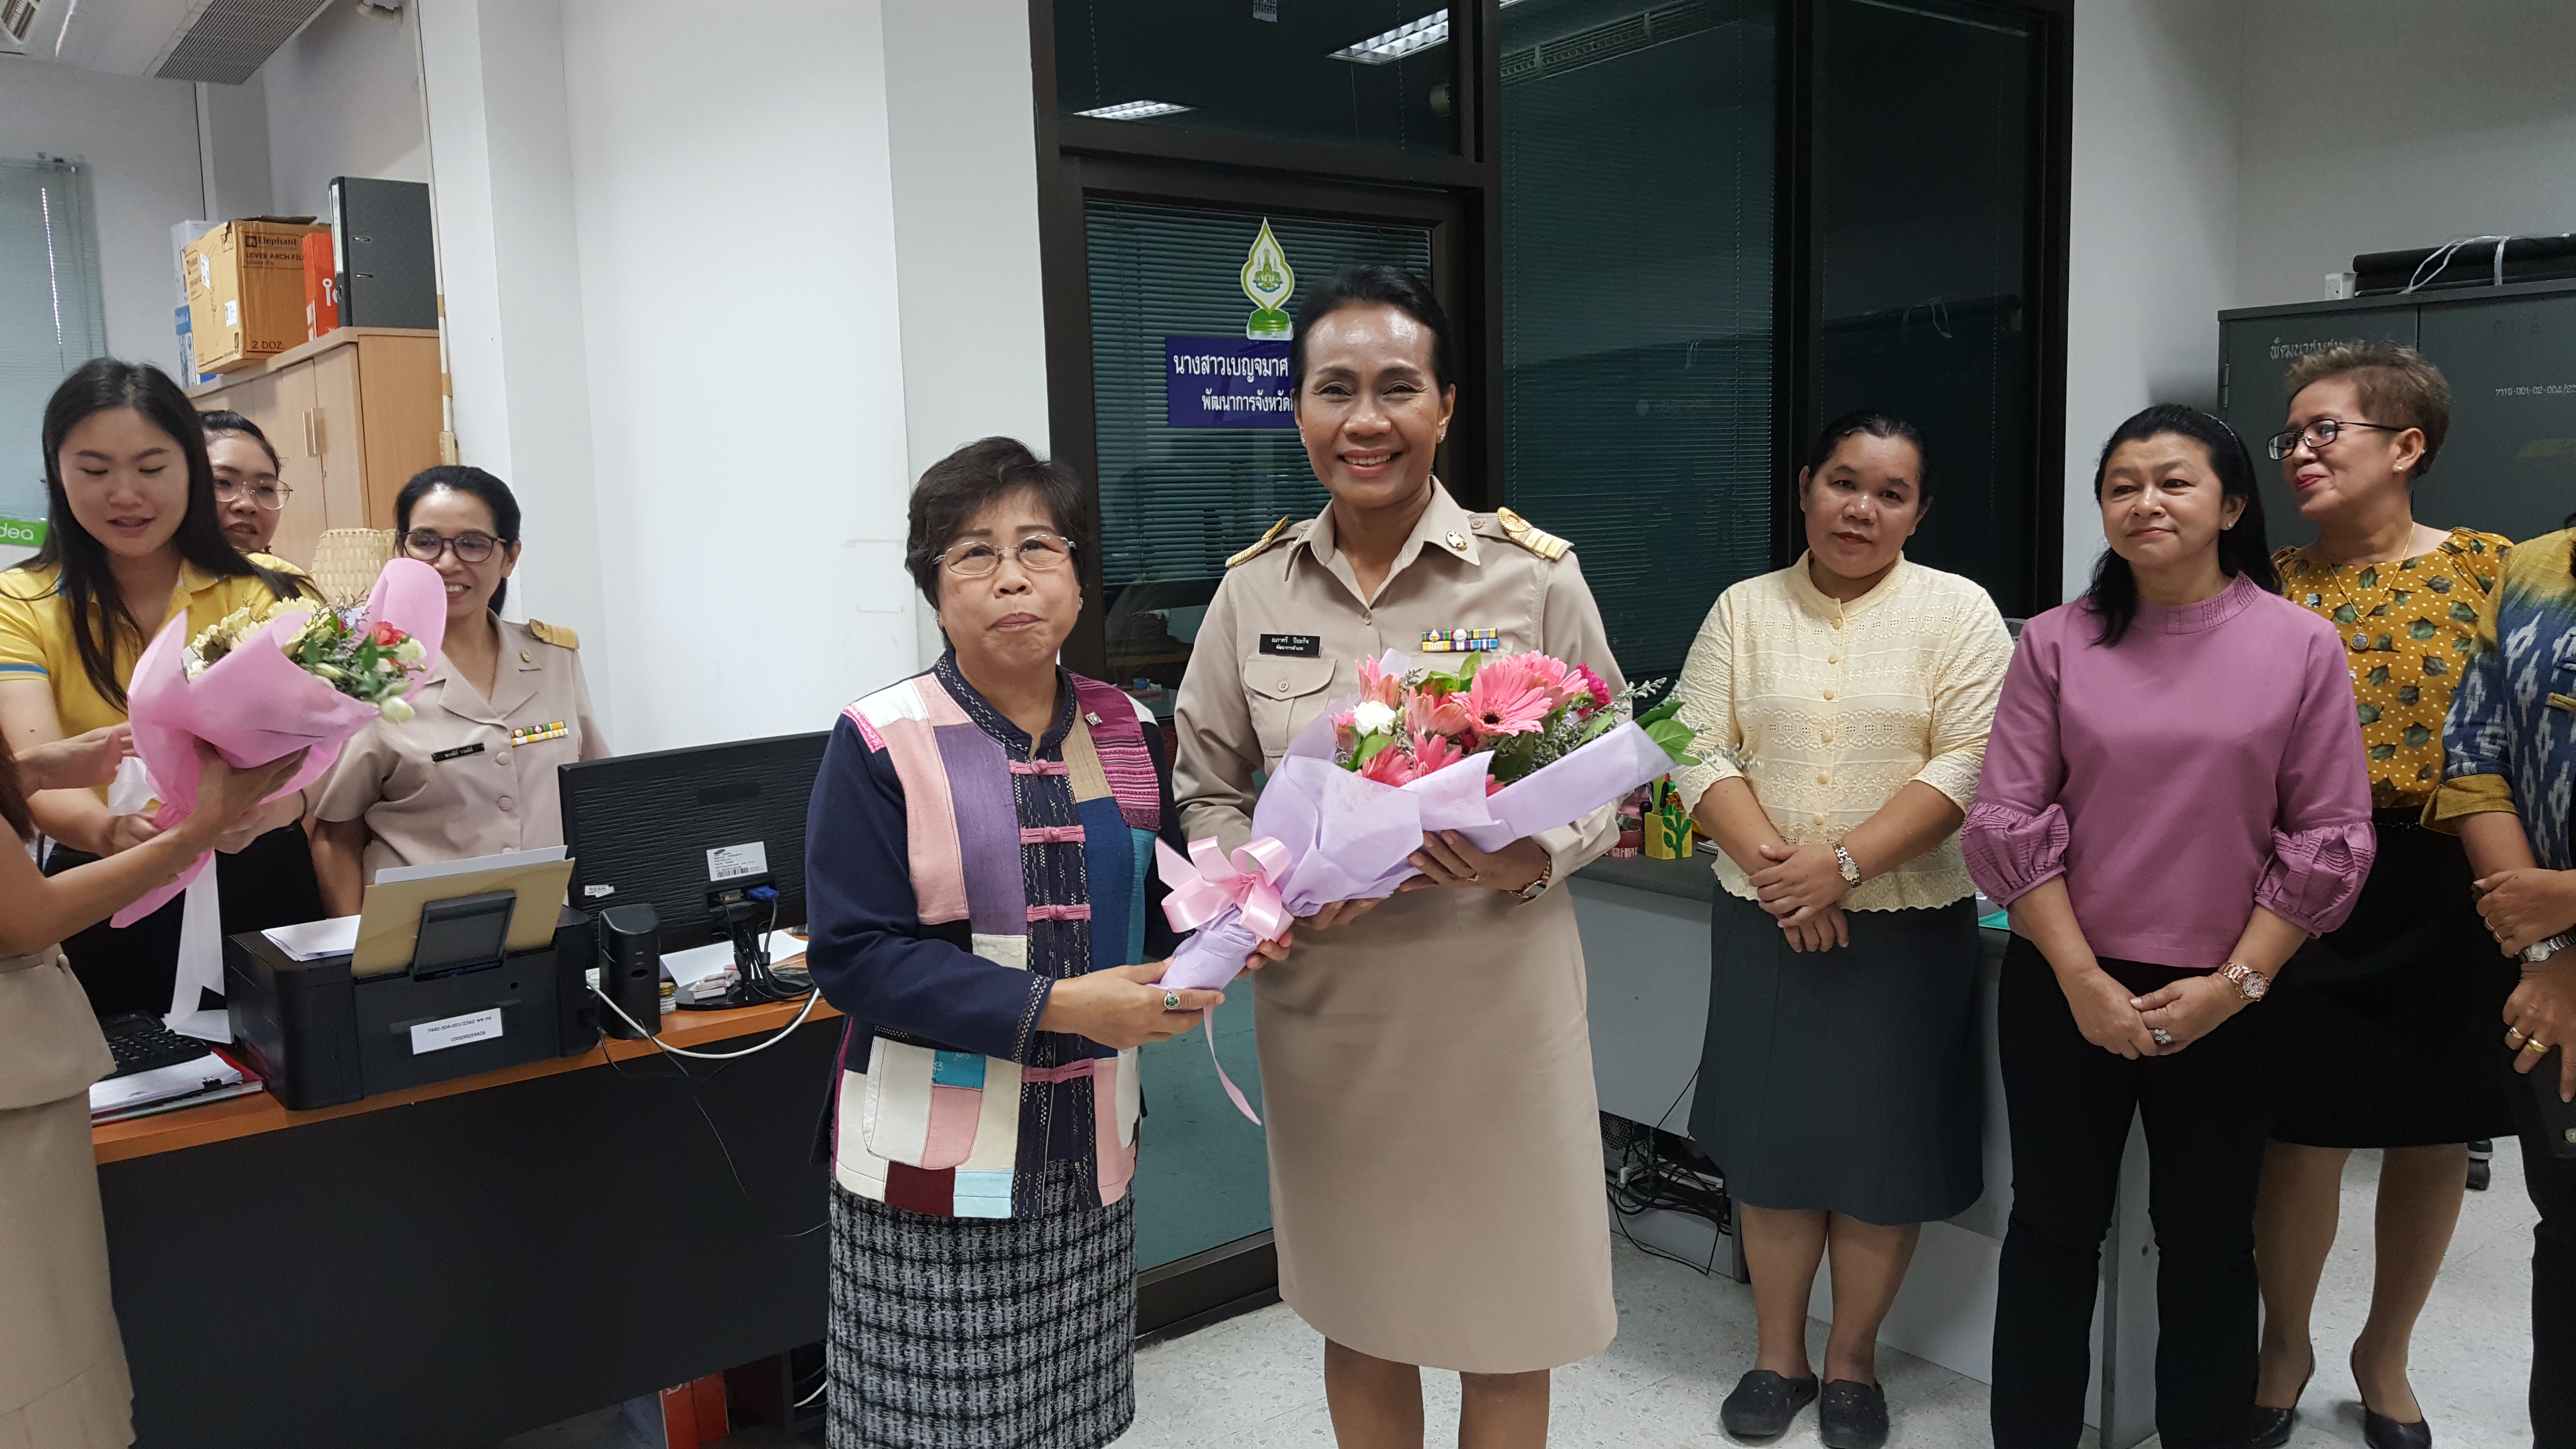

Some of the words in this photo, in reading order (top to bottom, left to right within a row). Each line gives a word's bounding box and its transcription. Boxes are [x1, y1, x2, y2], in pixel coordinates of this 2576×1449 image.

[258, 236, 297, 246] Elephant
[252, 341, 258, 349] 2
[1174, 355, 1288, 383] นางสาวเบญจมาศ
